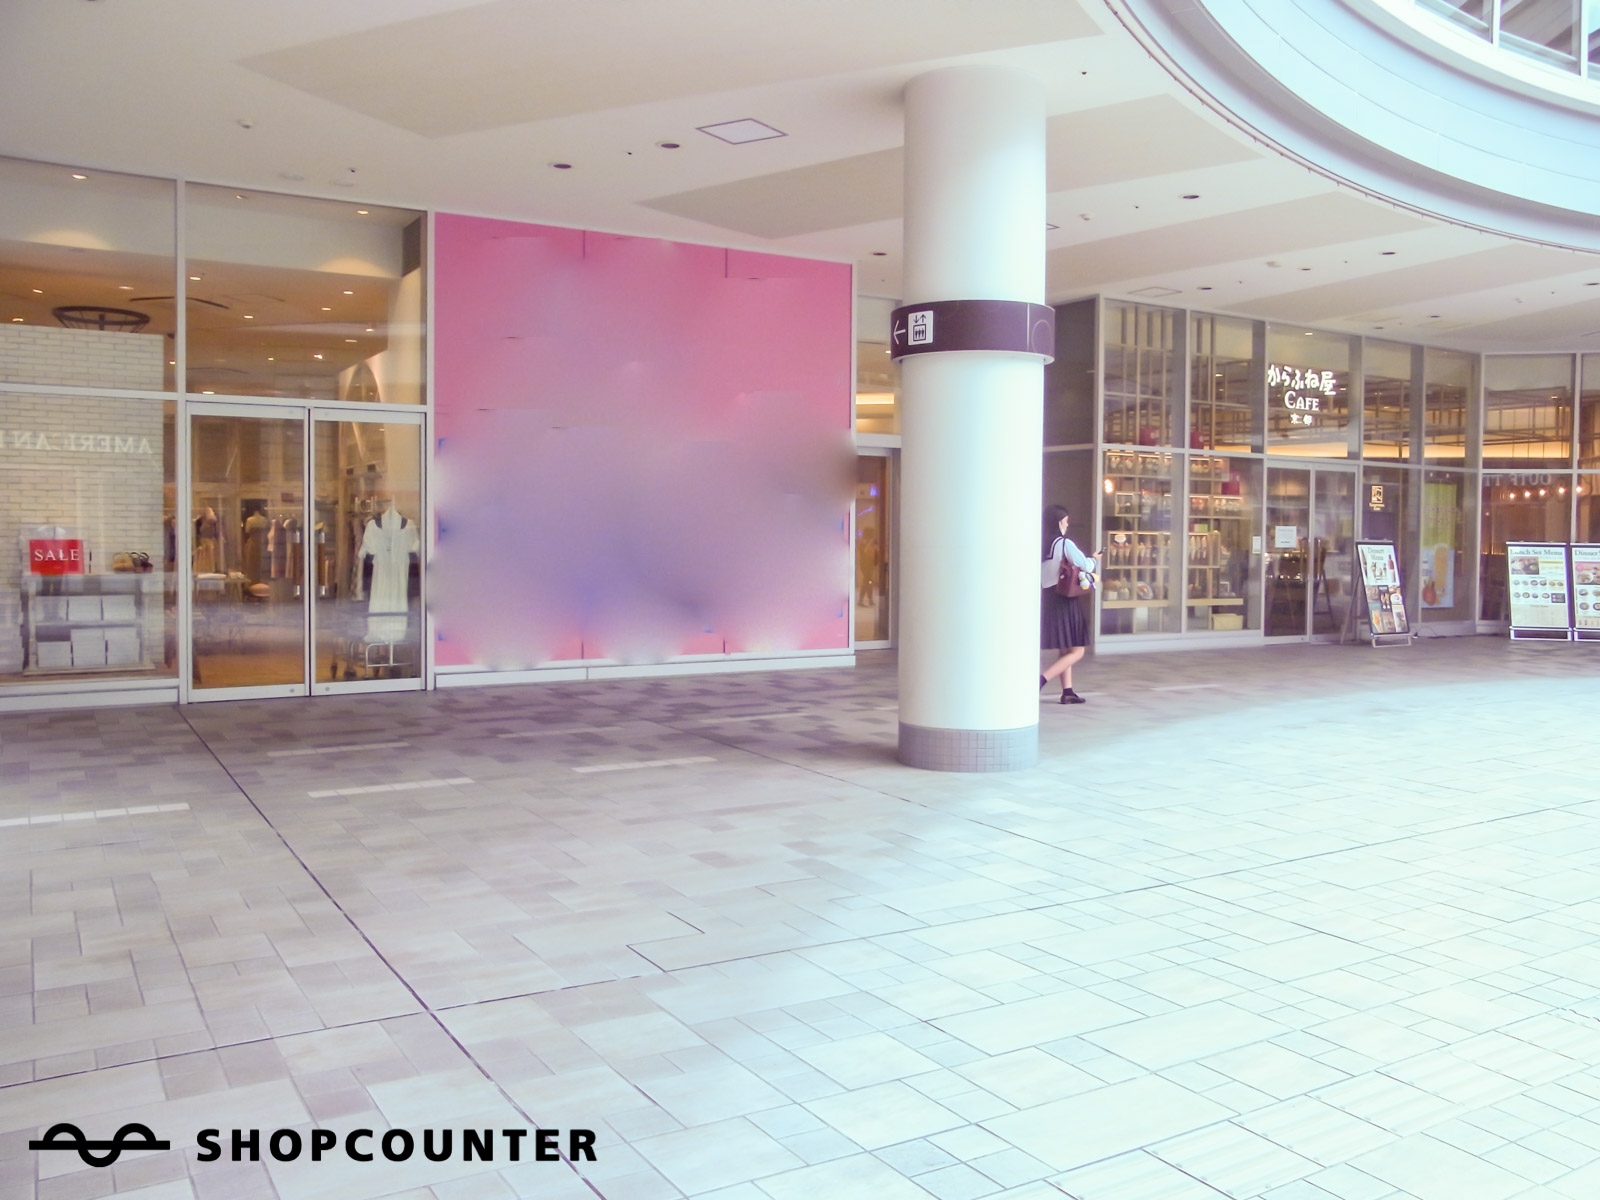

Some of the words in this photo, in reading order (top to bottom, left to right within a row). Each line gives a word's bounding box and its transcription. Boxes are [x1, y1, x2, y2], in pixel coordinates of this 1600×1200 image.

[1268, 364, 1336, 395] からふね屋
[34, 548, 80, 562] SALE
